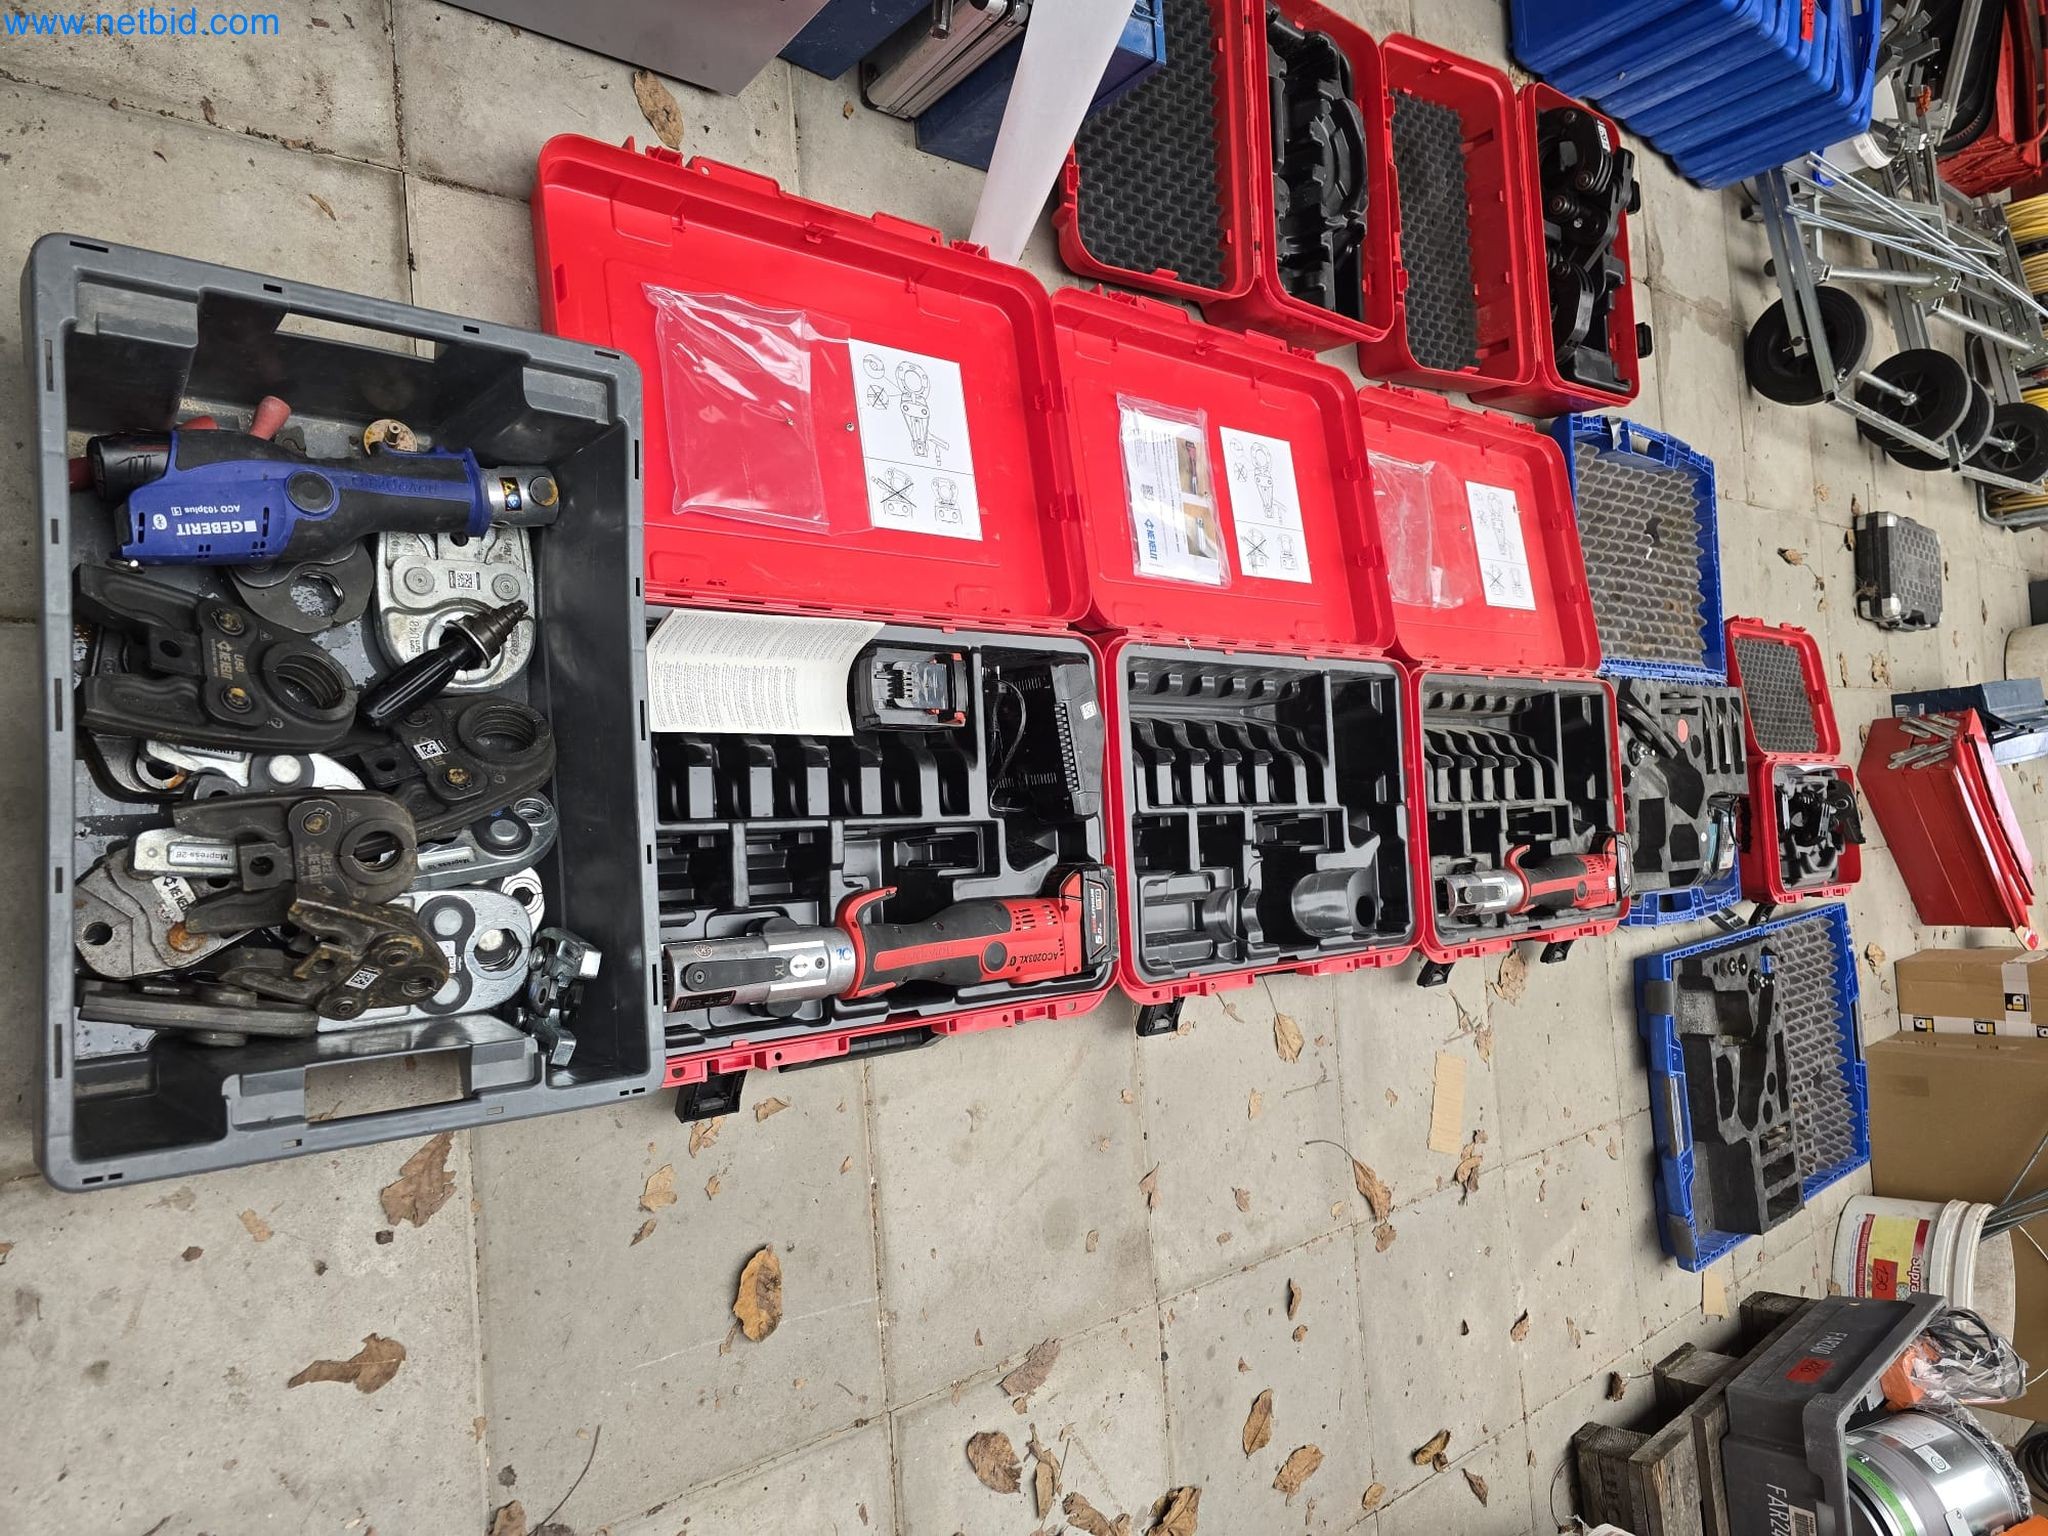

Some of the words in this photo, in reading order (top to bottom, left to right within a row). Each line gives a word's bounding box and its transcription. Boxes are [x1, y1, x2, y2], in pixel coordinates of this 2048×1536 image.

[183, 504, 219, 515] 103plus
[220, 504, 241, 515] ACO
[176, 520, 244, 536] GEBERIT
[1147, 540, 1158, 561] KELIT
[234, 653, 246, 673] U50
[189, 851, 228, 862] Mapress
[1019, 951, 1059, 965] ACO203XL
[774, 962, 785, 977] XL
[1908, 1257, 1925, 1292] Supra
[1810, 1331, 1848, 1356] FAR240
